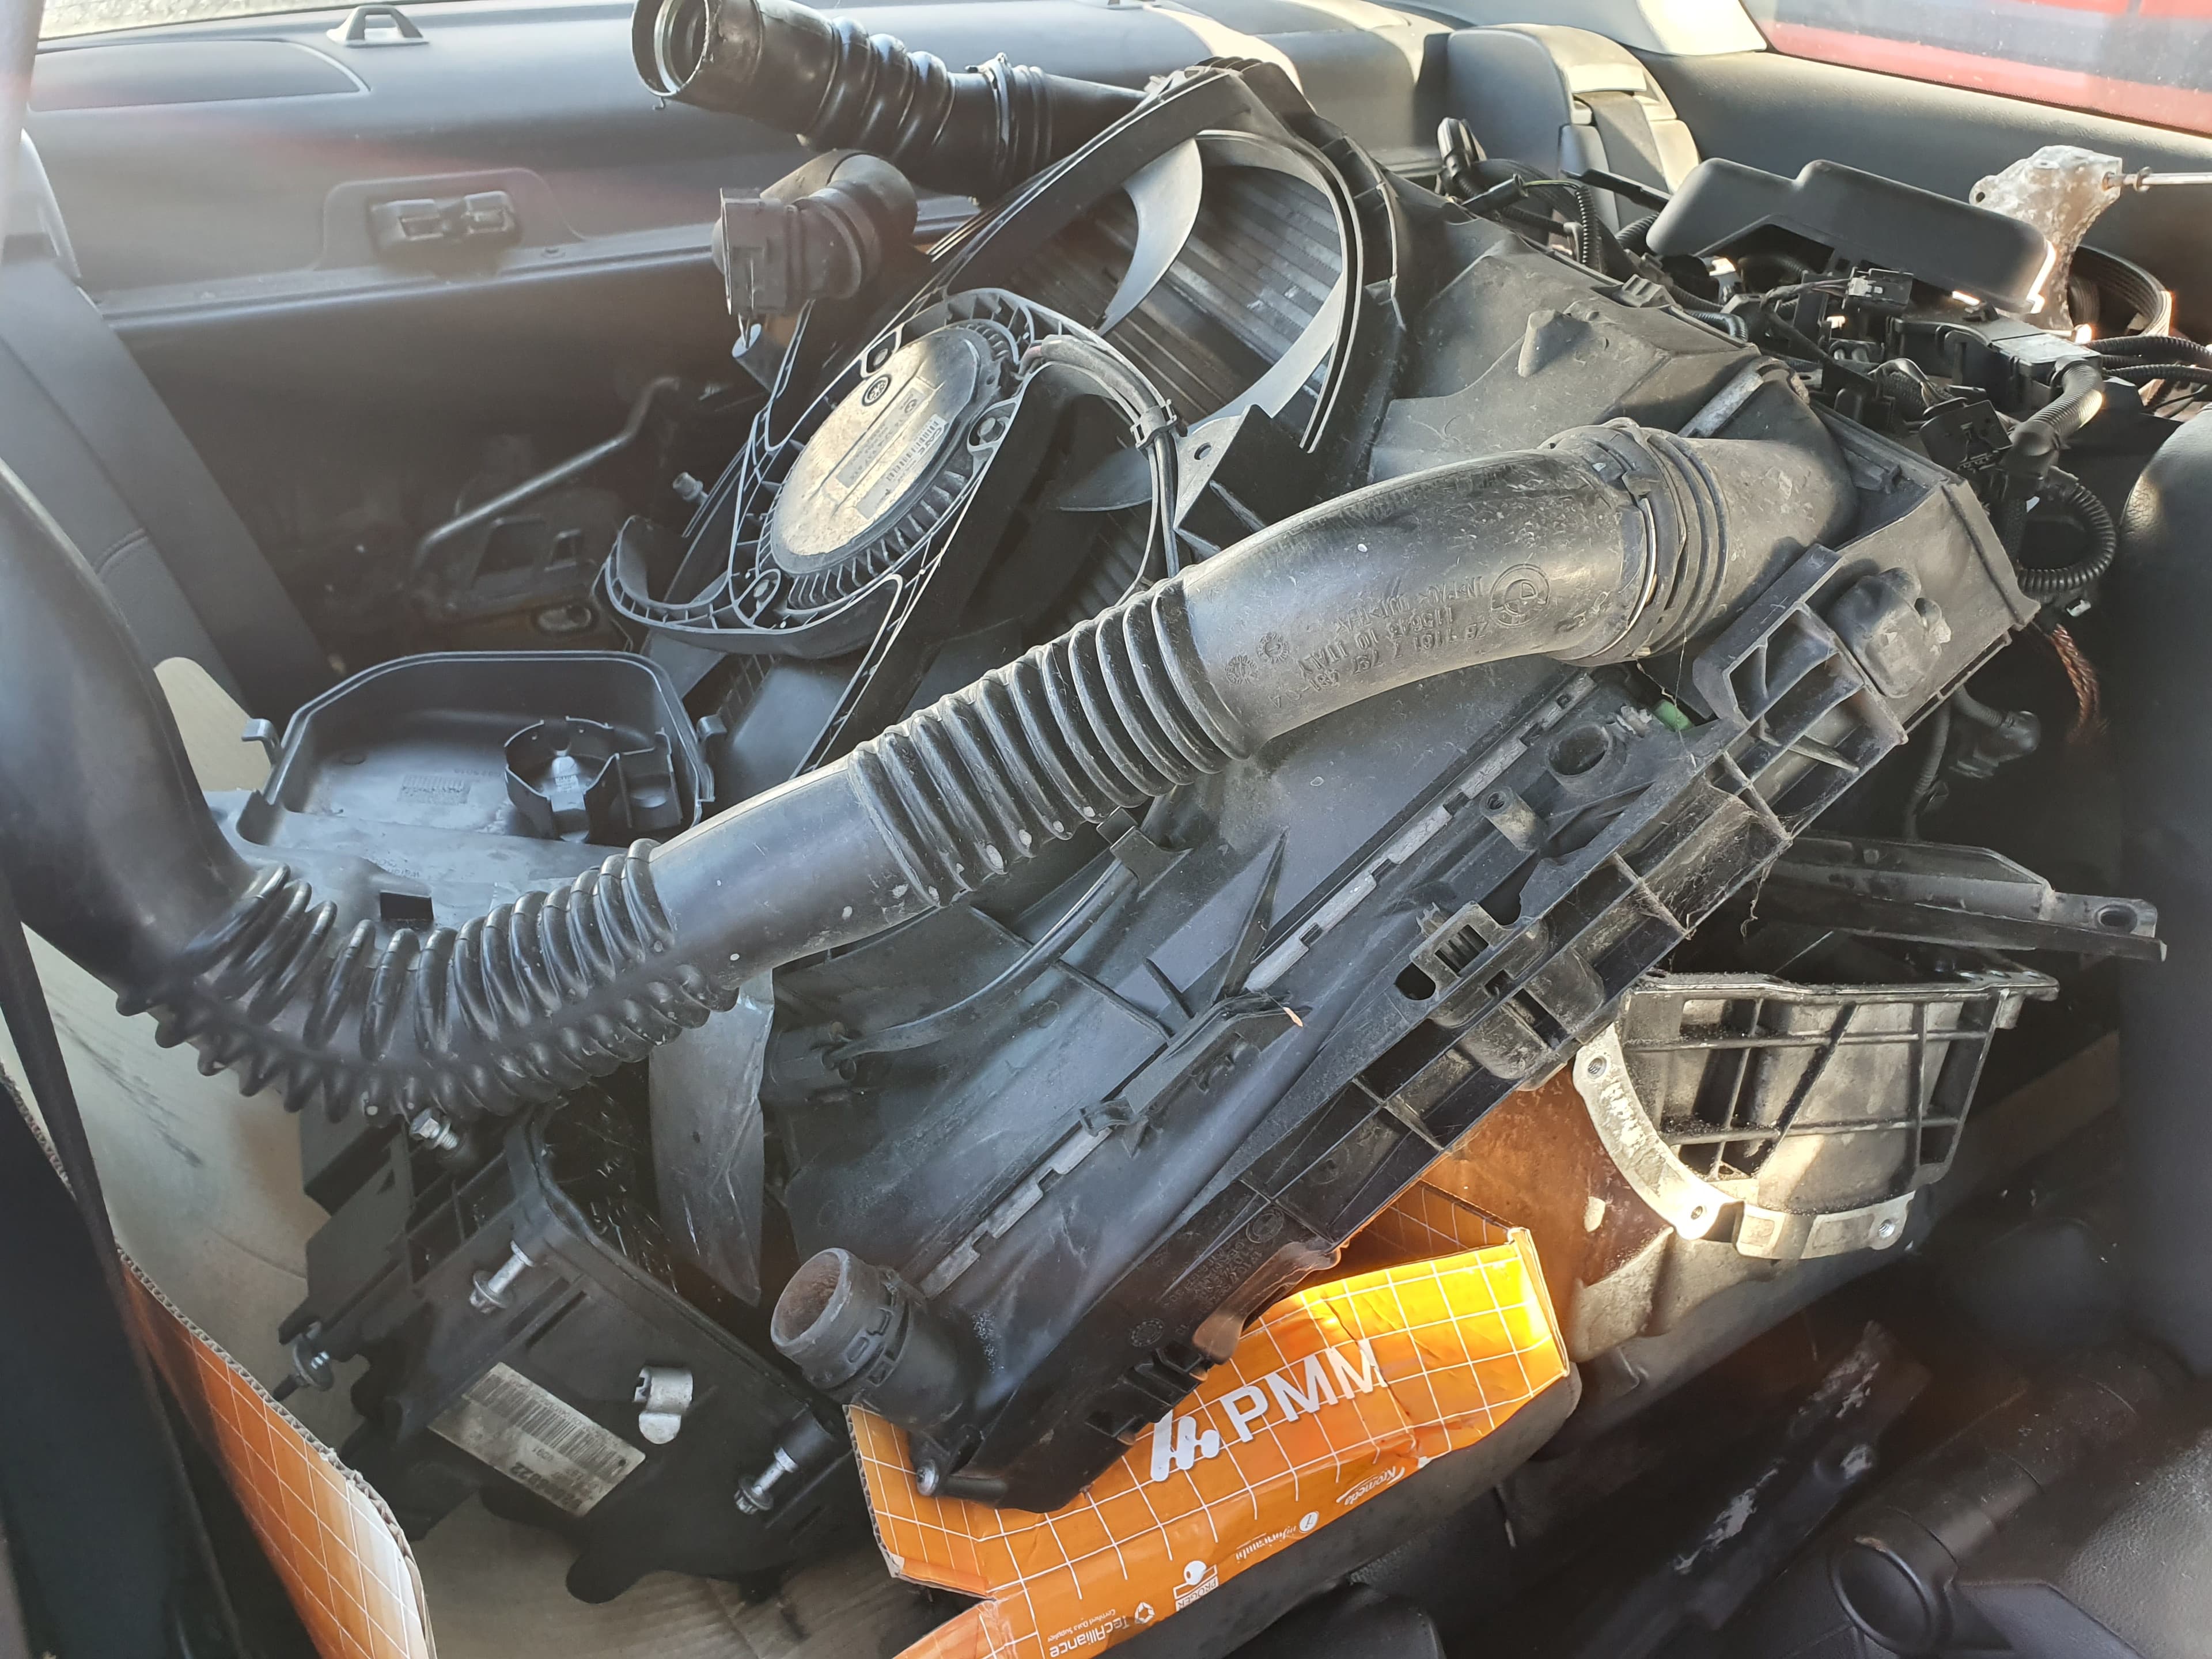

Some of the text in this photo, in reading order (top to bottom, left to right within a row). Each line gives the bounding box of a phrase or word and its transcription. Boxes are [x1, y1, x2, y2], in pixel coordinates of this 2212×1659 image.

[1295, 641, 1349, 677] ITALY
[1218, 1336, 1388, 1444] PMM
[1177, 1578, 1217, 1609] PROGER
[1047, 1627, 1073, 1643] Supplier
[1048, 1614, 1130, 1658] TecAlliance
[1073, 1620, 1089, 1631] Data
